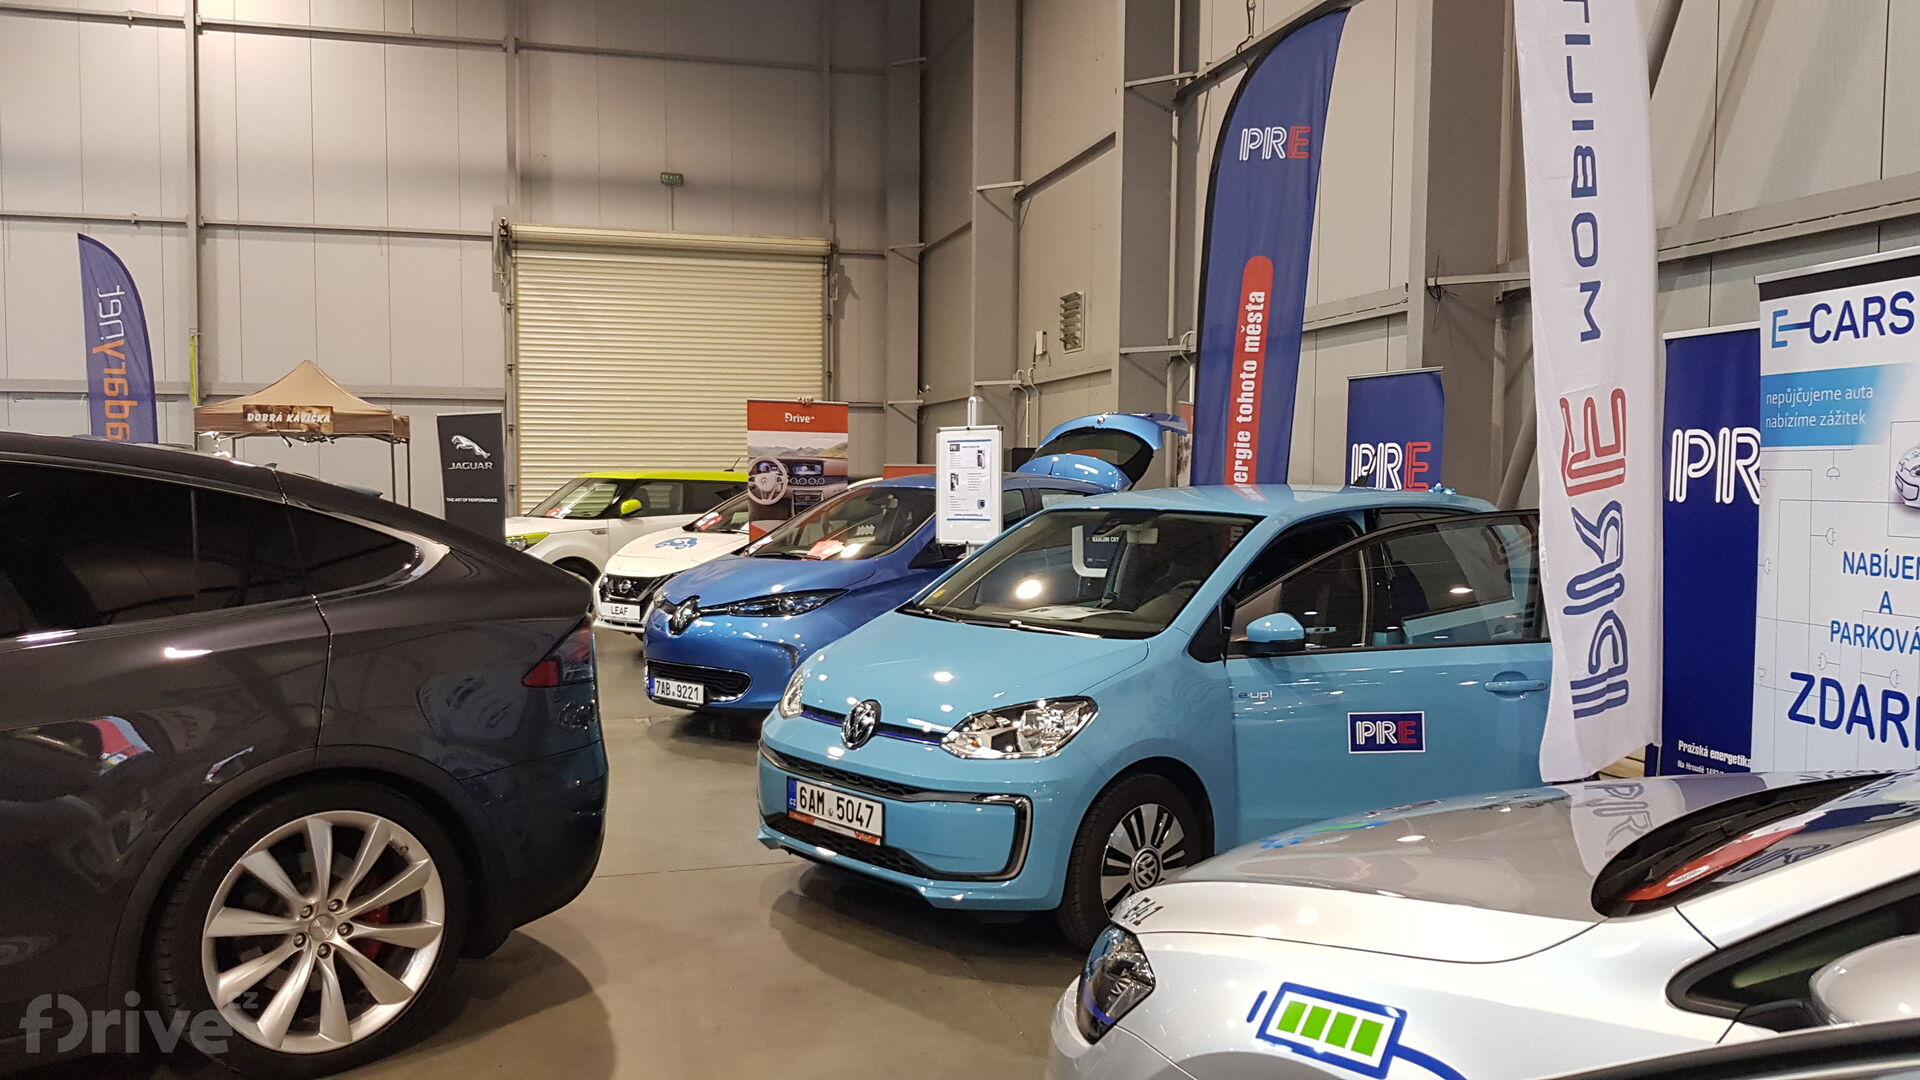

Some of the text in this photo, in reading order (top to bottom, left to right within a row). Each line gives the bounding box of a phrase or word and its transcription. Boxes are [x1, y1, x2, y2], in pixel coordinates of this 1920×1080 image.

[1239, 126, 1312, 161] PRE
[1240, 291, 1266, 353] města
[1771, 291, 1915, 348] E-CARS
[1236, 359, 1258, 423] tohoto
[1766, 386, 1873, 407] nepůjčujeme auta
[1766, 408, 1866, 429] nabízíme zážitek
[448, 462, 493, 470] JAGUAR
[1351, 442, 1432, 491] PRE
[610, 606, 629, 616] LEAF
[1879, 590, 1893, 614] A
[656, 680, 699, 701] 7AB 9221
[1787, 671, 1920, 751] ZDAR
[1356, 720, 1417, 745] PRE
[1678, 740, 1752, 768] Pražská energetika
[799, 786, 874, 829] 6AM 5047
